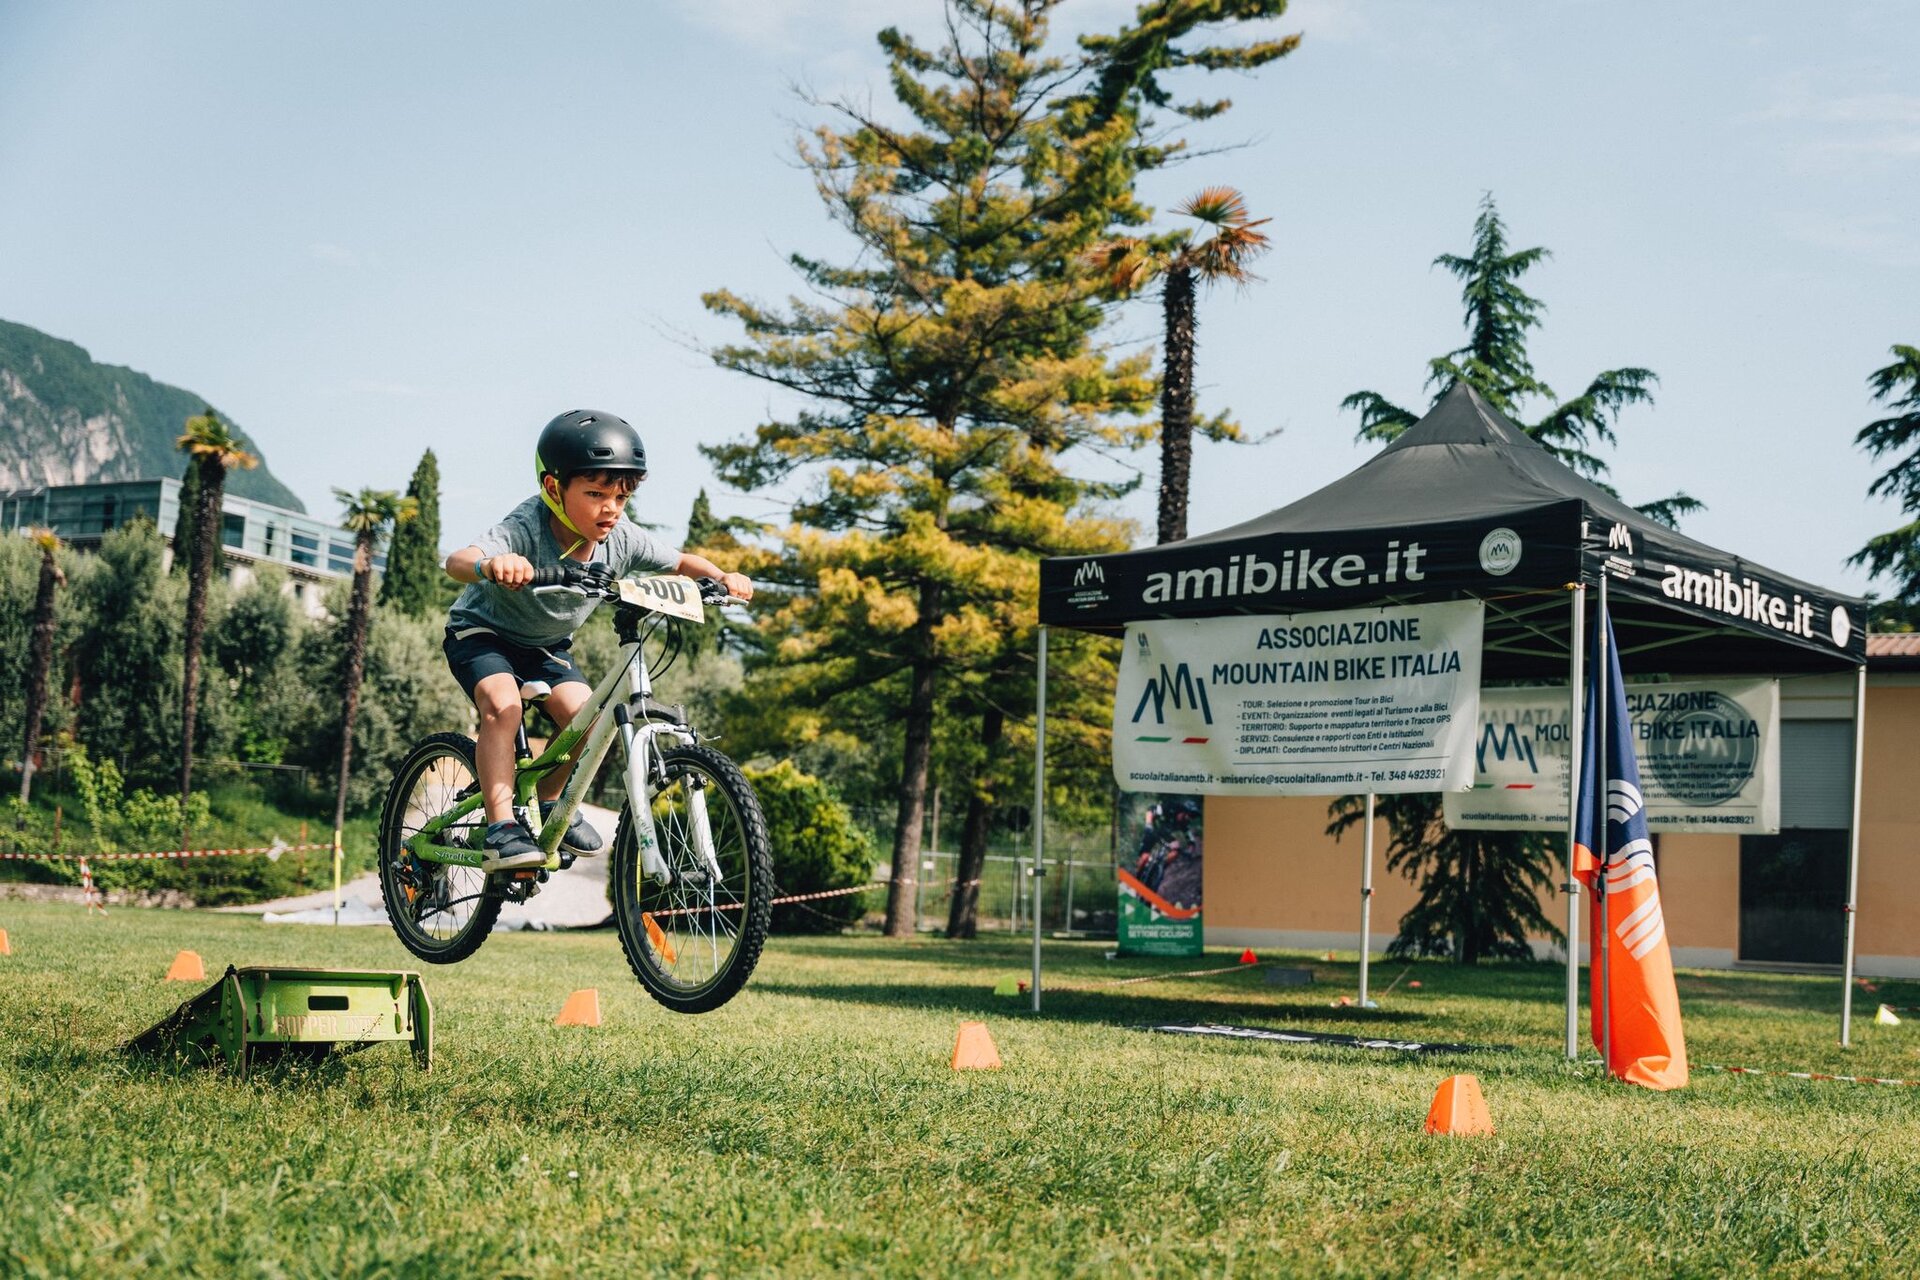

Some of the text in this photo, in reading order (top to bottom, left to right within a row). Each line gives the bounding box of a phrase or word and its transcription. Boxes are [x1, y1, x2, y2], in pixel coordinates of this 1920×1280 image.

[1142, 540, 1427, 604] amibike.it
[634, 579, 685, 605] 400
[1661, 564, 1814, 639] amibike.it
[1257, 618, 1421, 649] ASSOCIAZIONE
[1212, 651, 1461, 685] MOUNTAIN BIKE ITALIA
[1241, 711, 1272, 720] EVENTI:
[1273, 711, 1328, 721] Organizzazione
[1331, 709, 1353, 718] eventi
[1354, 708, 1375, 718] legati
[1376, 708, 1383, 716] al
[1384, 706, 1413, 715] Turismo
[1420, 704, 1433, 712] alla
[1434, 703, 1448, 712] Bici
[1242, 700, 1265, 709] TOUR:
[1266, 699, 1302, 708] Selezione
[1309, 698, 1353, 708] promozione
[1354, 697, 1370, 705] Tour
[1372, 696, 1378, 704] in
[1380, 695, 1394, 704] Bici
[1625, 691, 1717, 712] CIAZIONE
[1289, 723, 1323, 732] Supporto
[1330, 721, 1369, 730] mappatura
[1371, 719, 1403, 728] territorio
[1411, 717, 1435, 725] Tracce
[1436, 714, 1451, 723] GPS
[1640, 719, 1760, 740] BIKE ITALIA
[1282, 745, 1337, 754] Coordinamento
[1379, 742, 1400, 751] Centri
[1402, 740, 1434, 750] Nazionali
[1321, 732, 1351, 742] rapporti
[1367, 731, 1382, 740] Enti
[1130, 771, 1213, 783] scuolaitalianamtb.it
[1220, 771, 1363, 784] amiservice@scuolaitalianamtb.it
[1370, 771, 1386, 782] Tel.
[1388, 770, 1406, 781] 348
[1408, 768, 1446, 780] 4923921
